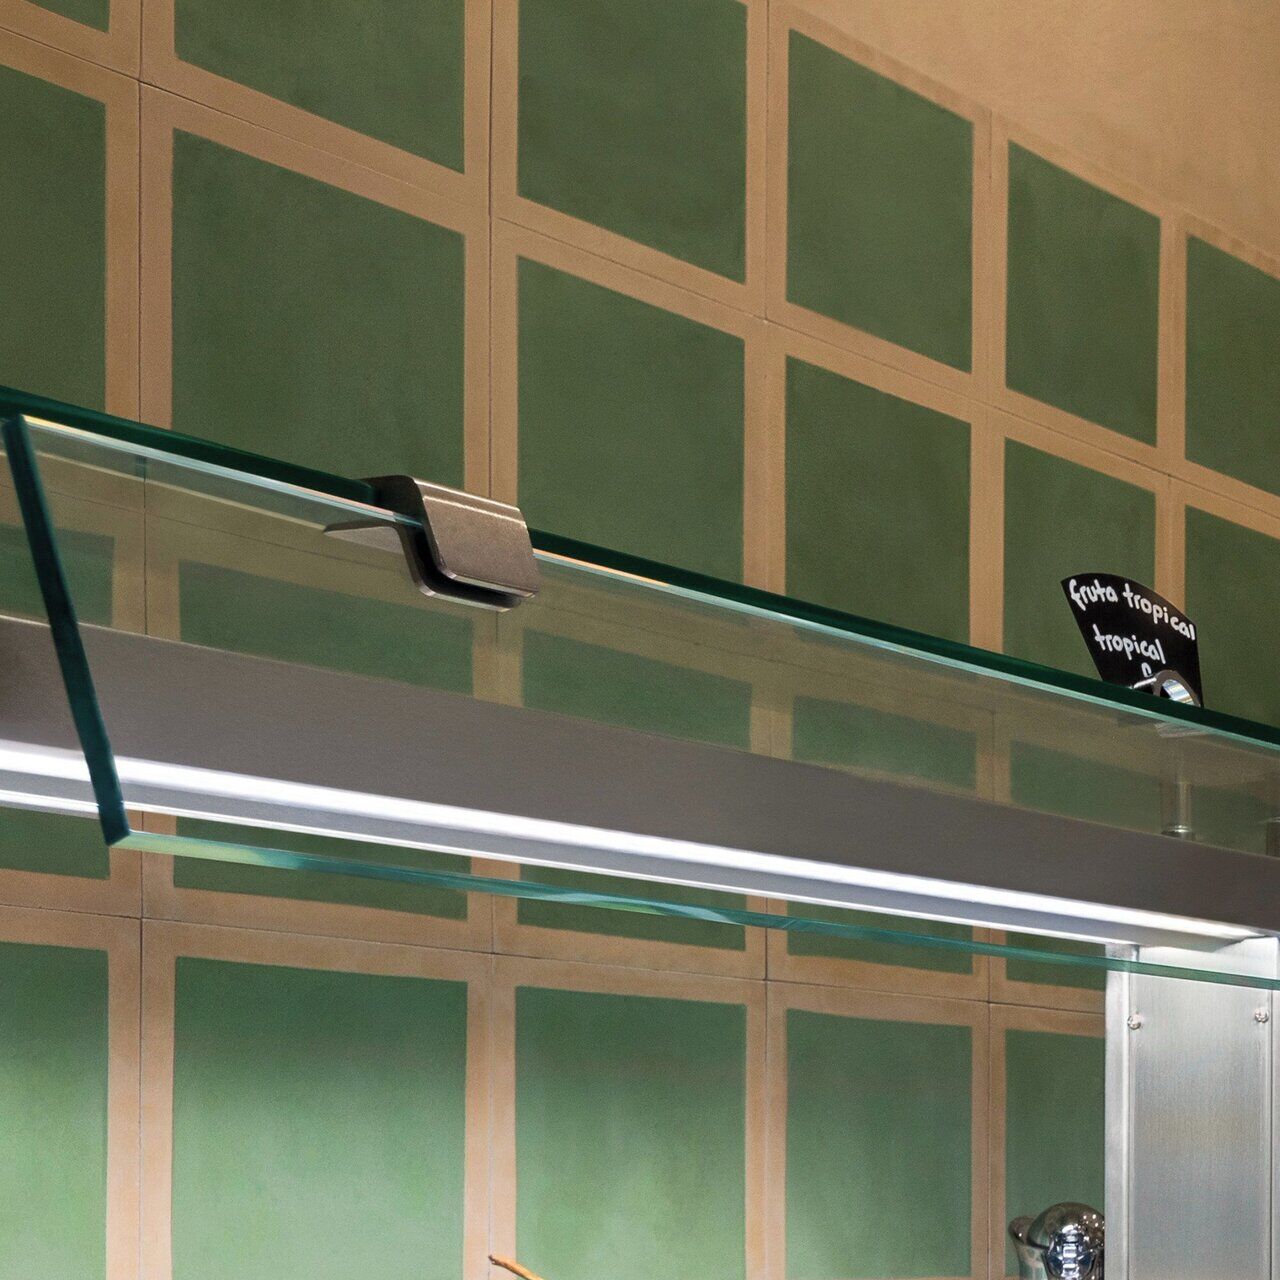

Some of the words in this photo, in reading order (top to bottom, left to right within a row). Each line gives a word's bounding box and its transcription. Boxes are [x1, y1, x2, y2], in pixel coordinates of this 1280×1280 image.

[1069, 578, 1118, 611] fruta
[1122, 582, 1196, 641] tropical
[1092, 623, 1166, 664] tropical
